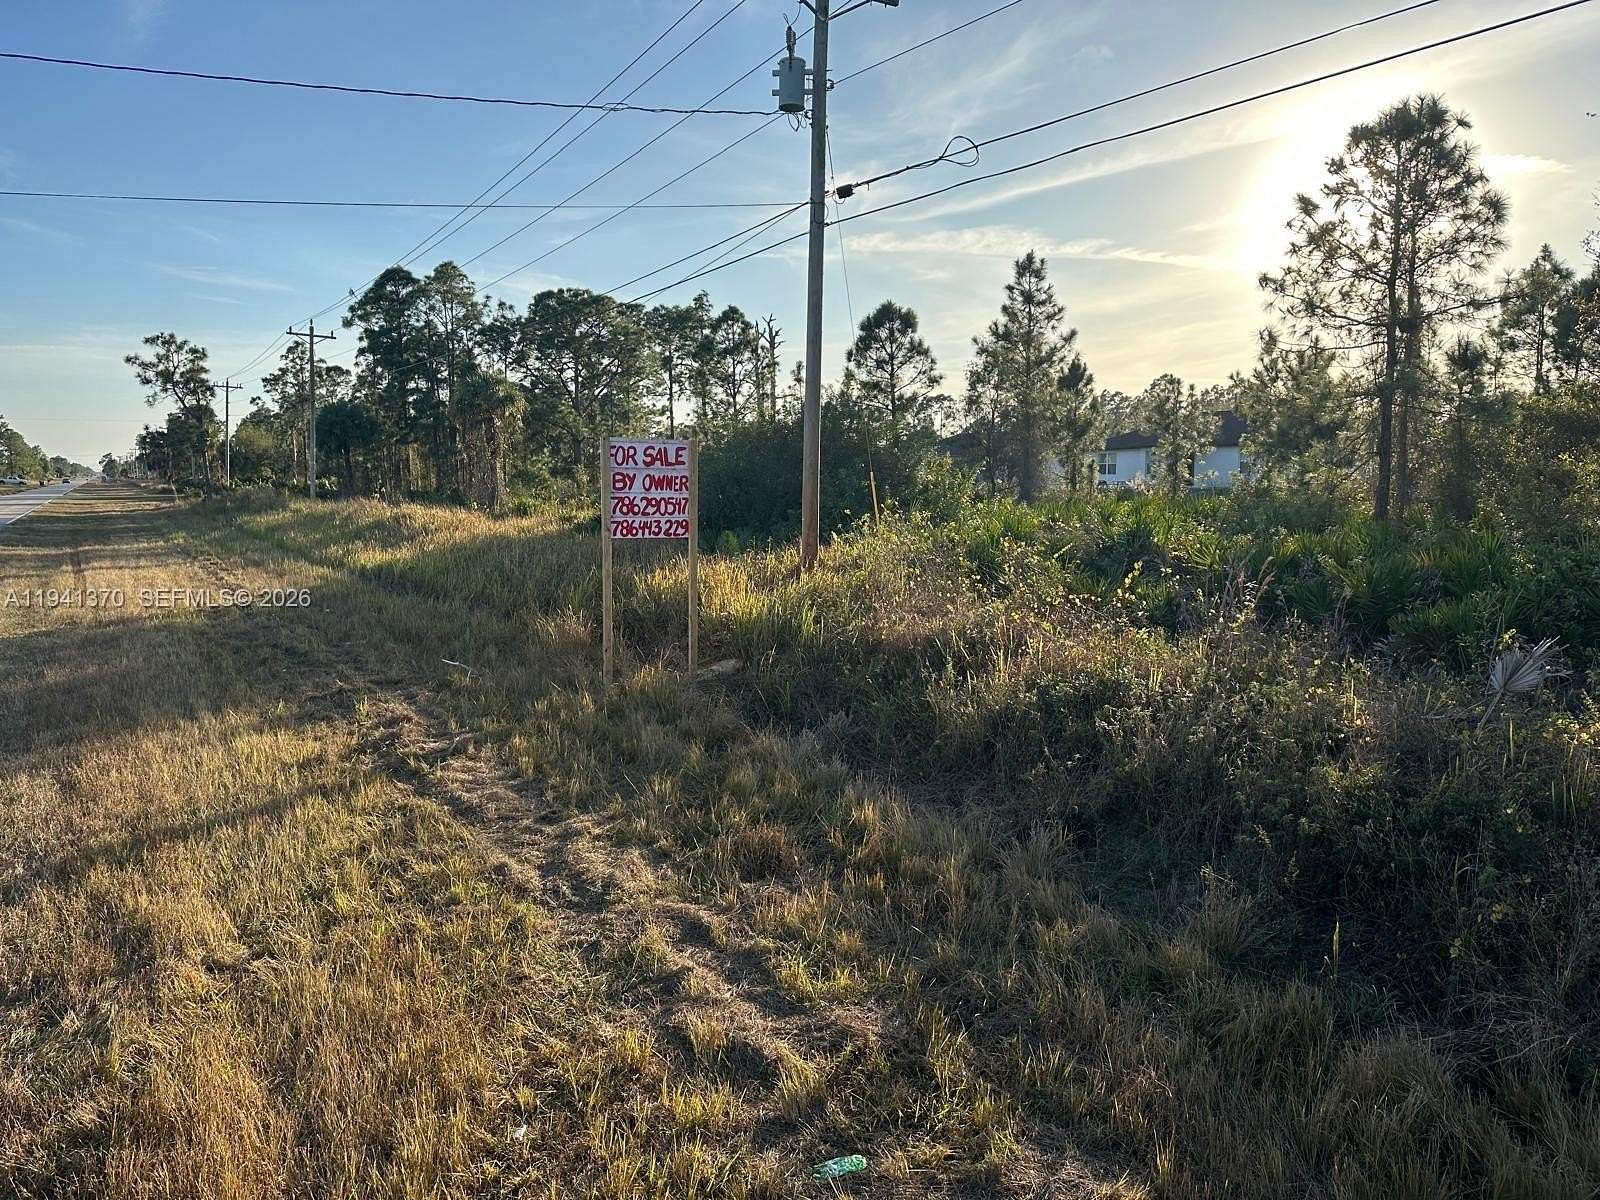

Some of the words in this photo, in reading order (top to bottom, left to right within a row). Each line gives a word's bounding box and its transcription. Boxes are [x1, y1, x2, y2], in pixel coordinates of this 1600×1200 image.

[642, 445, 687, 467] SALE
[612, 472, 636, 491] BY
[642, 473, 689, 492] OWNER
